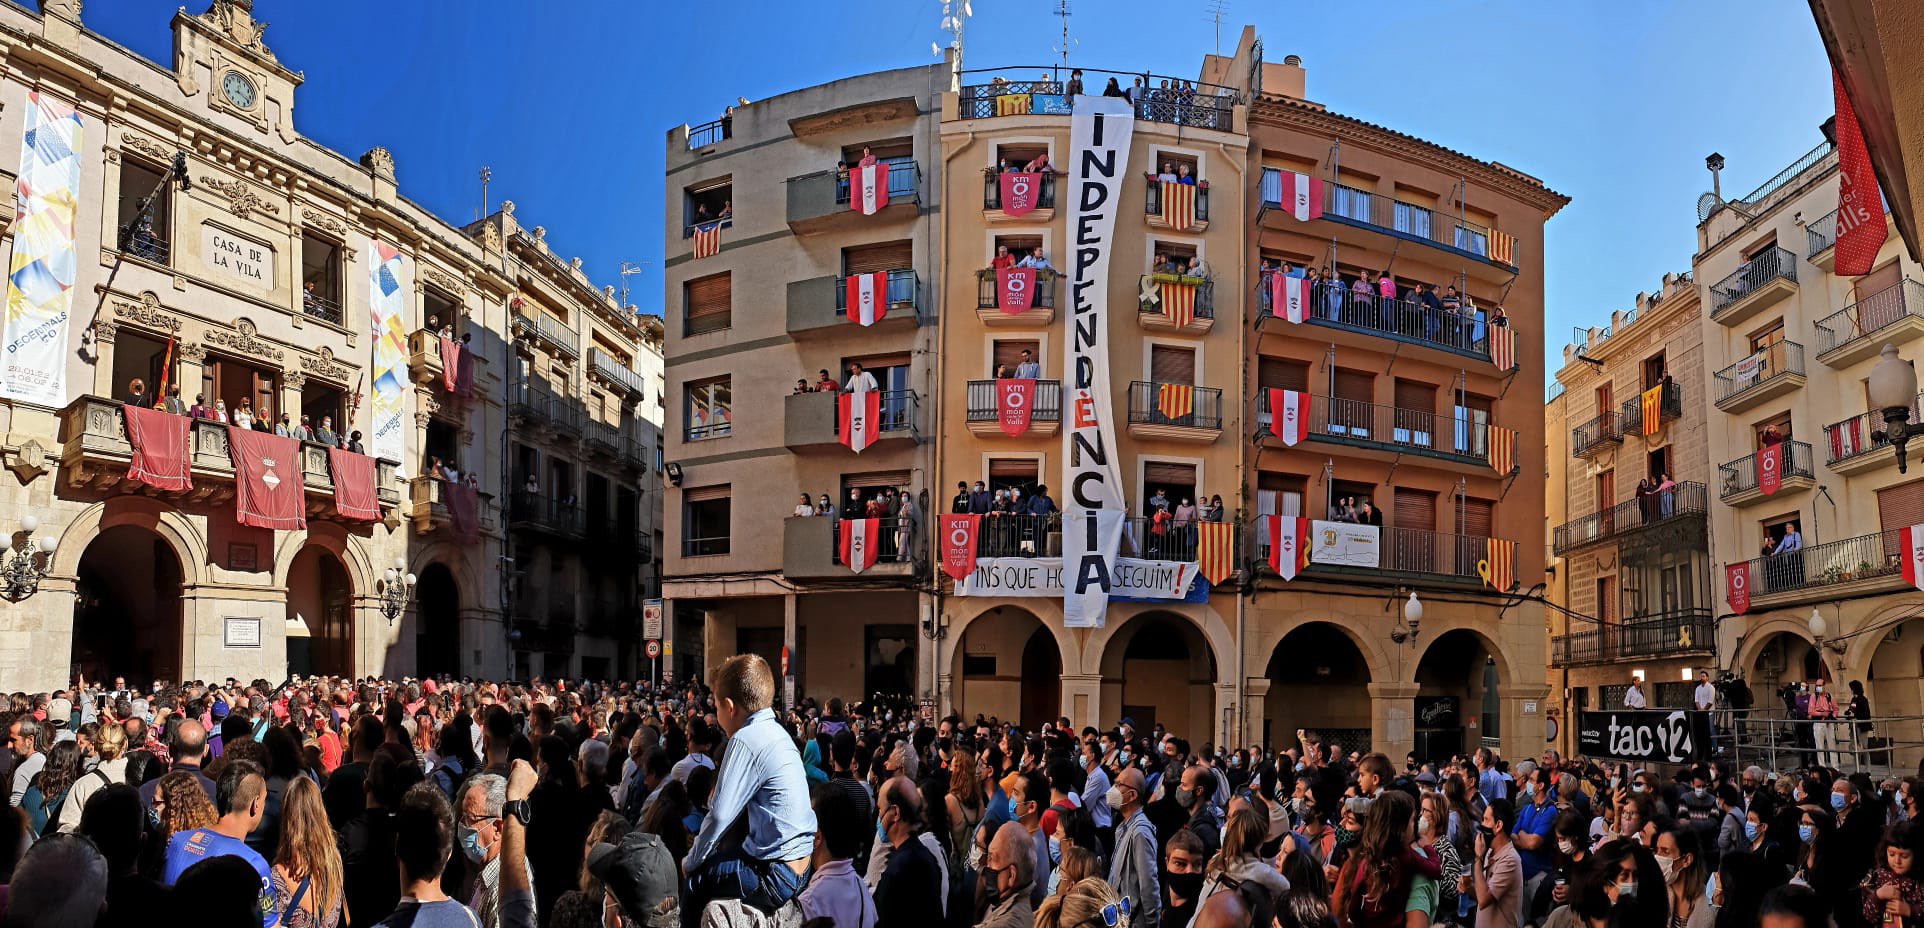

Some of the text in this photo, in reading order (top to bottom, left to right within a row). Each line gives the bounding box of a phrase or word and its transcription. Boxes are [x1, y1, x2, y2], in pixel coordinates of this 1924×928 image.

[1836, 204, 1871, 238] alls
[213, 235, 262, 263] CASA DE
[213, 252, 262, 280] LA VILA
[7, 311, 67, 354] DECENNALS
[961, 565, 1000, 589] INS
[1004, 566, 1039, 591] QUE
[1608, 714, 1654, 757] tac
